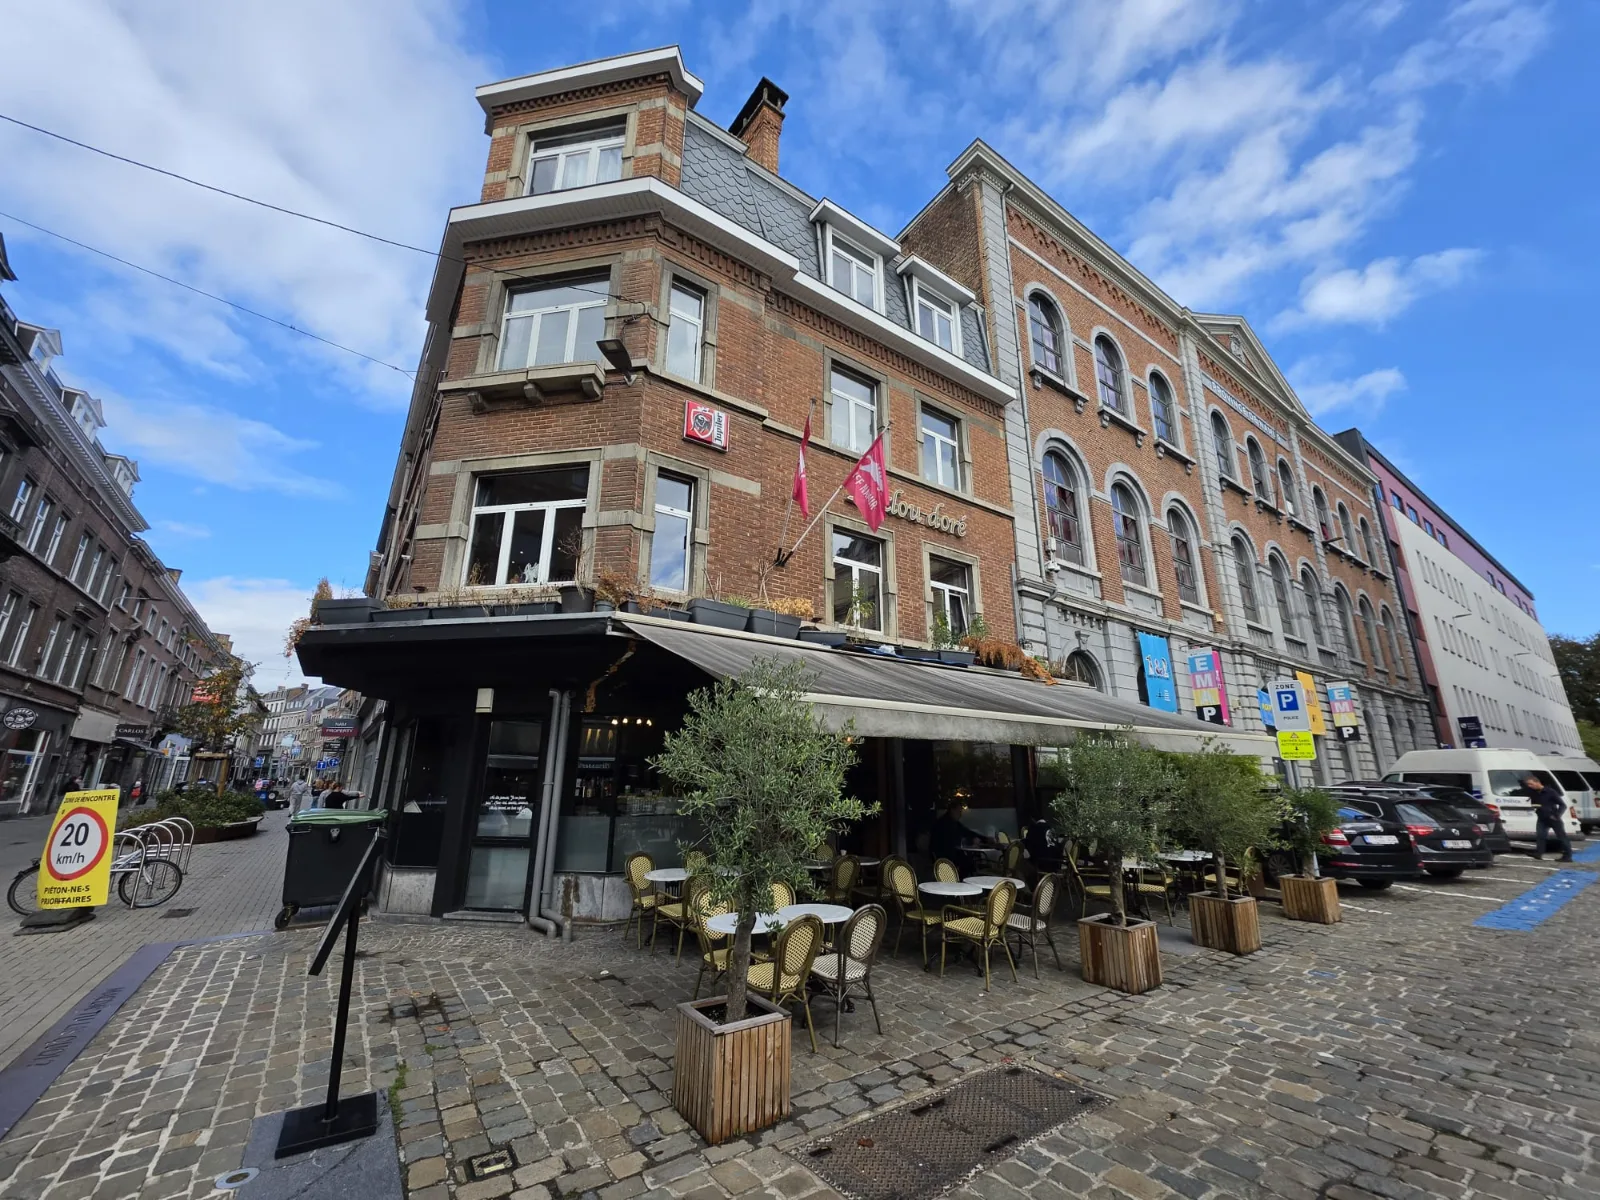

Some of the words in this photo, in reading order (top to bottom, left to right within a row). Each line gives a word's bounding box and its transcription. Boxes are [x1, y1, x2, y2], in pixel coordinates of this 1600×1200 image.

[715, 412, 723, 444] Jupiler
[927, 503, 966, 537] doré
[1280, 693, 1293, 708] P
[80, 794, 116, 803] RENCONTRE
[60, 822, 89, 847] 20
[56, 852, 85, 865] km/h
[40, 895, 92, 905] PRIORITAIRES
